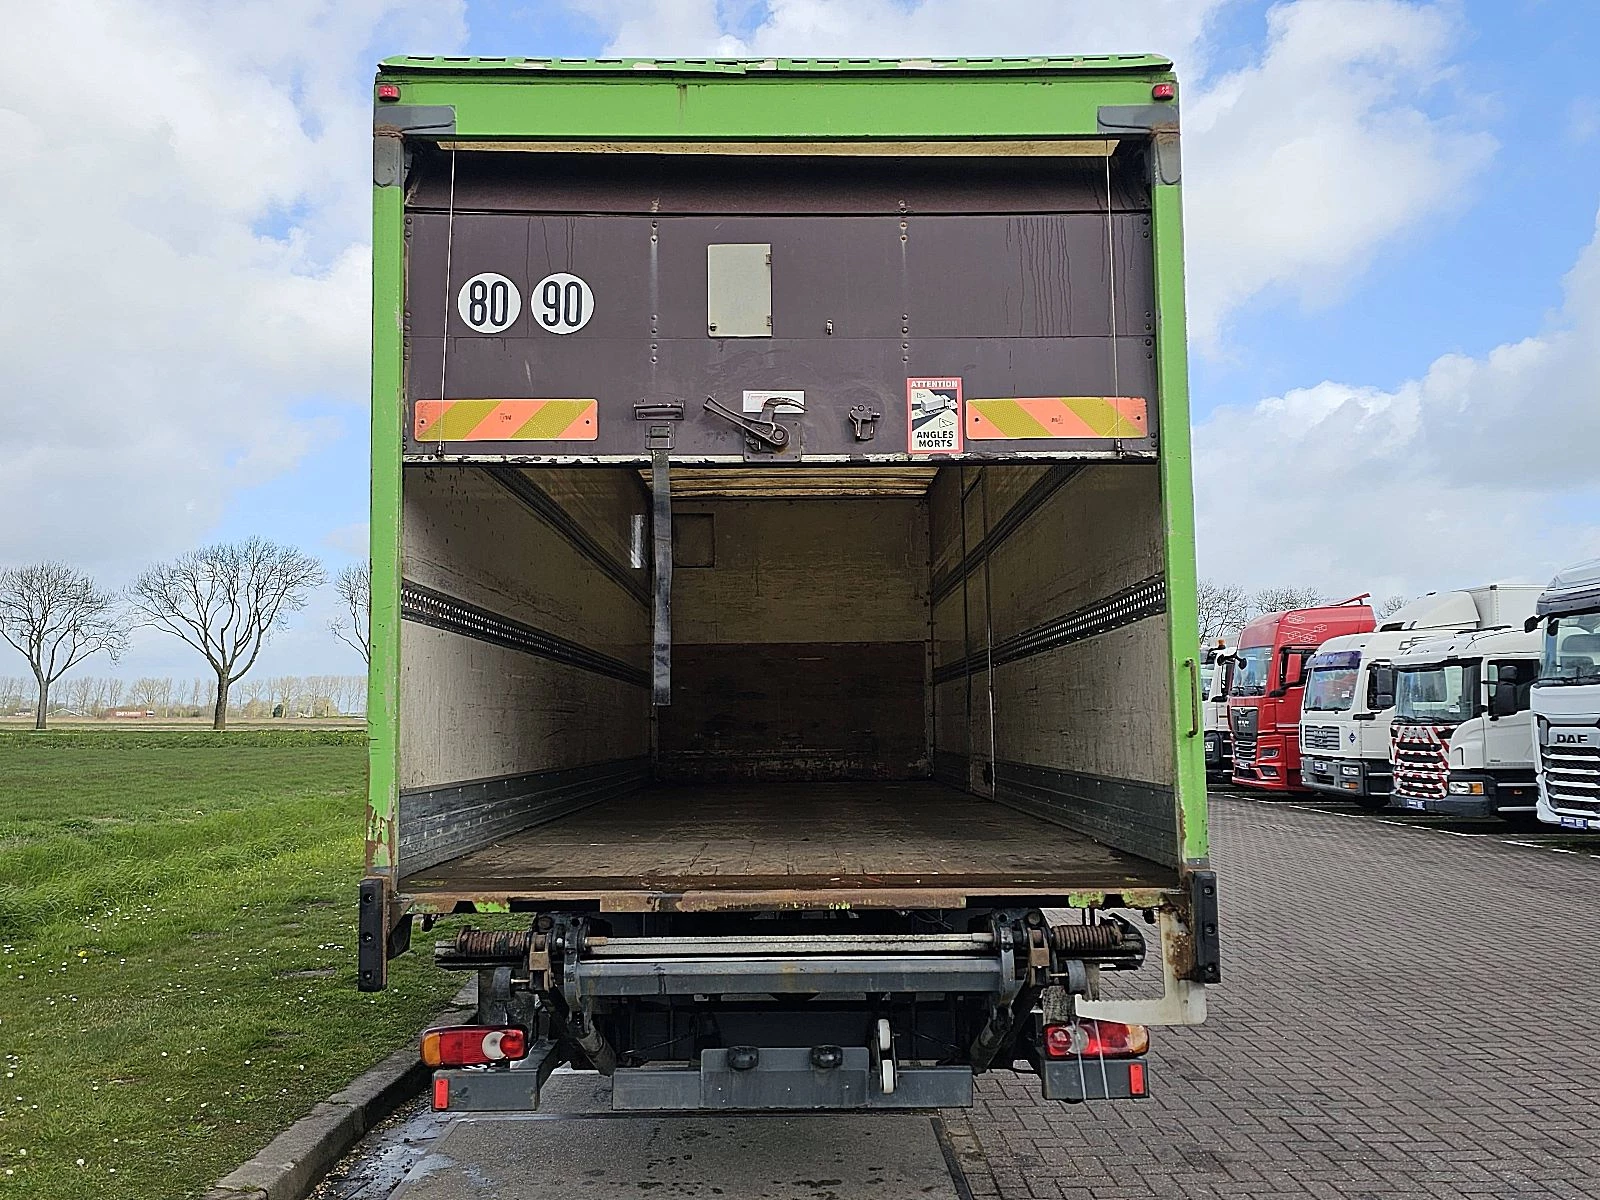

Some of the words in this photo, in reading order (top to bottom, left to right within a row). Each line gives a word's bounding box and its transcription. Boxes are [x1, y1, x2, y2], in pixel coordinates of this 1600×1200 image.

[469, 280, 509, 327] 80
[542, 281, 582, 327] 90
[916, 431, 954, 439] ANGLES
[918, 440, 953, 448] MORTS
[1556, 733, 1588, 744] DAF
